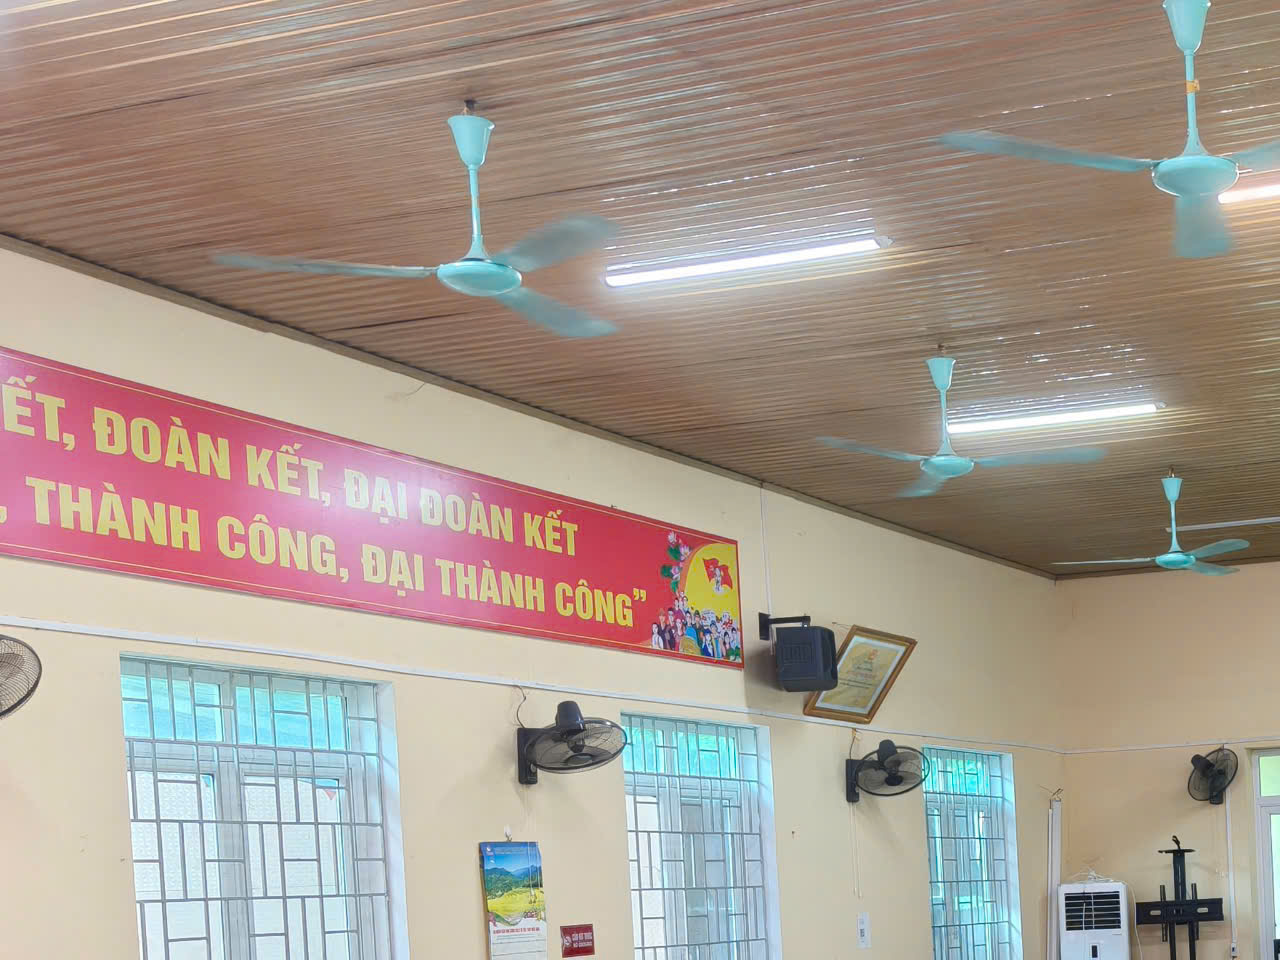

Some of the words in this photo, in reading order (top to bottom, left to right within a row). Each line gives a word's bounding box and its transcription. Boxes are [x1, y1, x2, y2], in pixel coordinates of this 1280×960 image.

[1, 375, 76, 451] ẾT,
[93, 406, 231, 481] ĐOÀN
[246, 442, 331, 507] KẾT,
[344, 468, 408, 524] ĐẠI
[419, 486, 514, 543] ĐOÀN
[523, 509, 578, 556] KẾT
[25, 475, 201, 551] THÀNH
[217, 514, 349, 582] CÔNG,
[361, 543, 425, 597] ĐẠI
[435, 558, 546, 613] THÀNH
